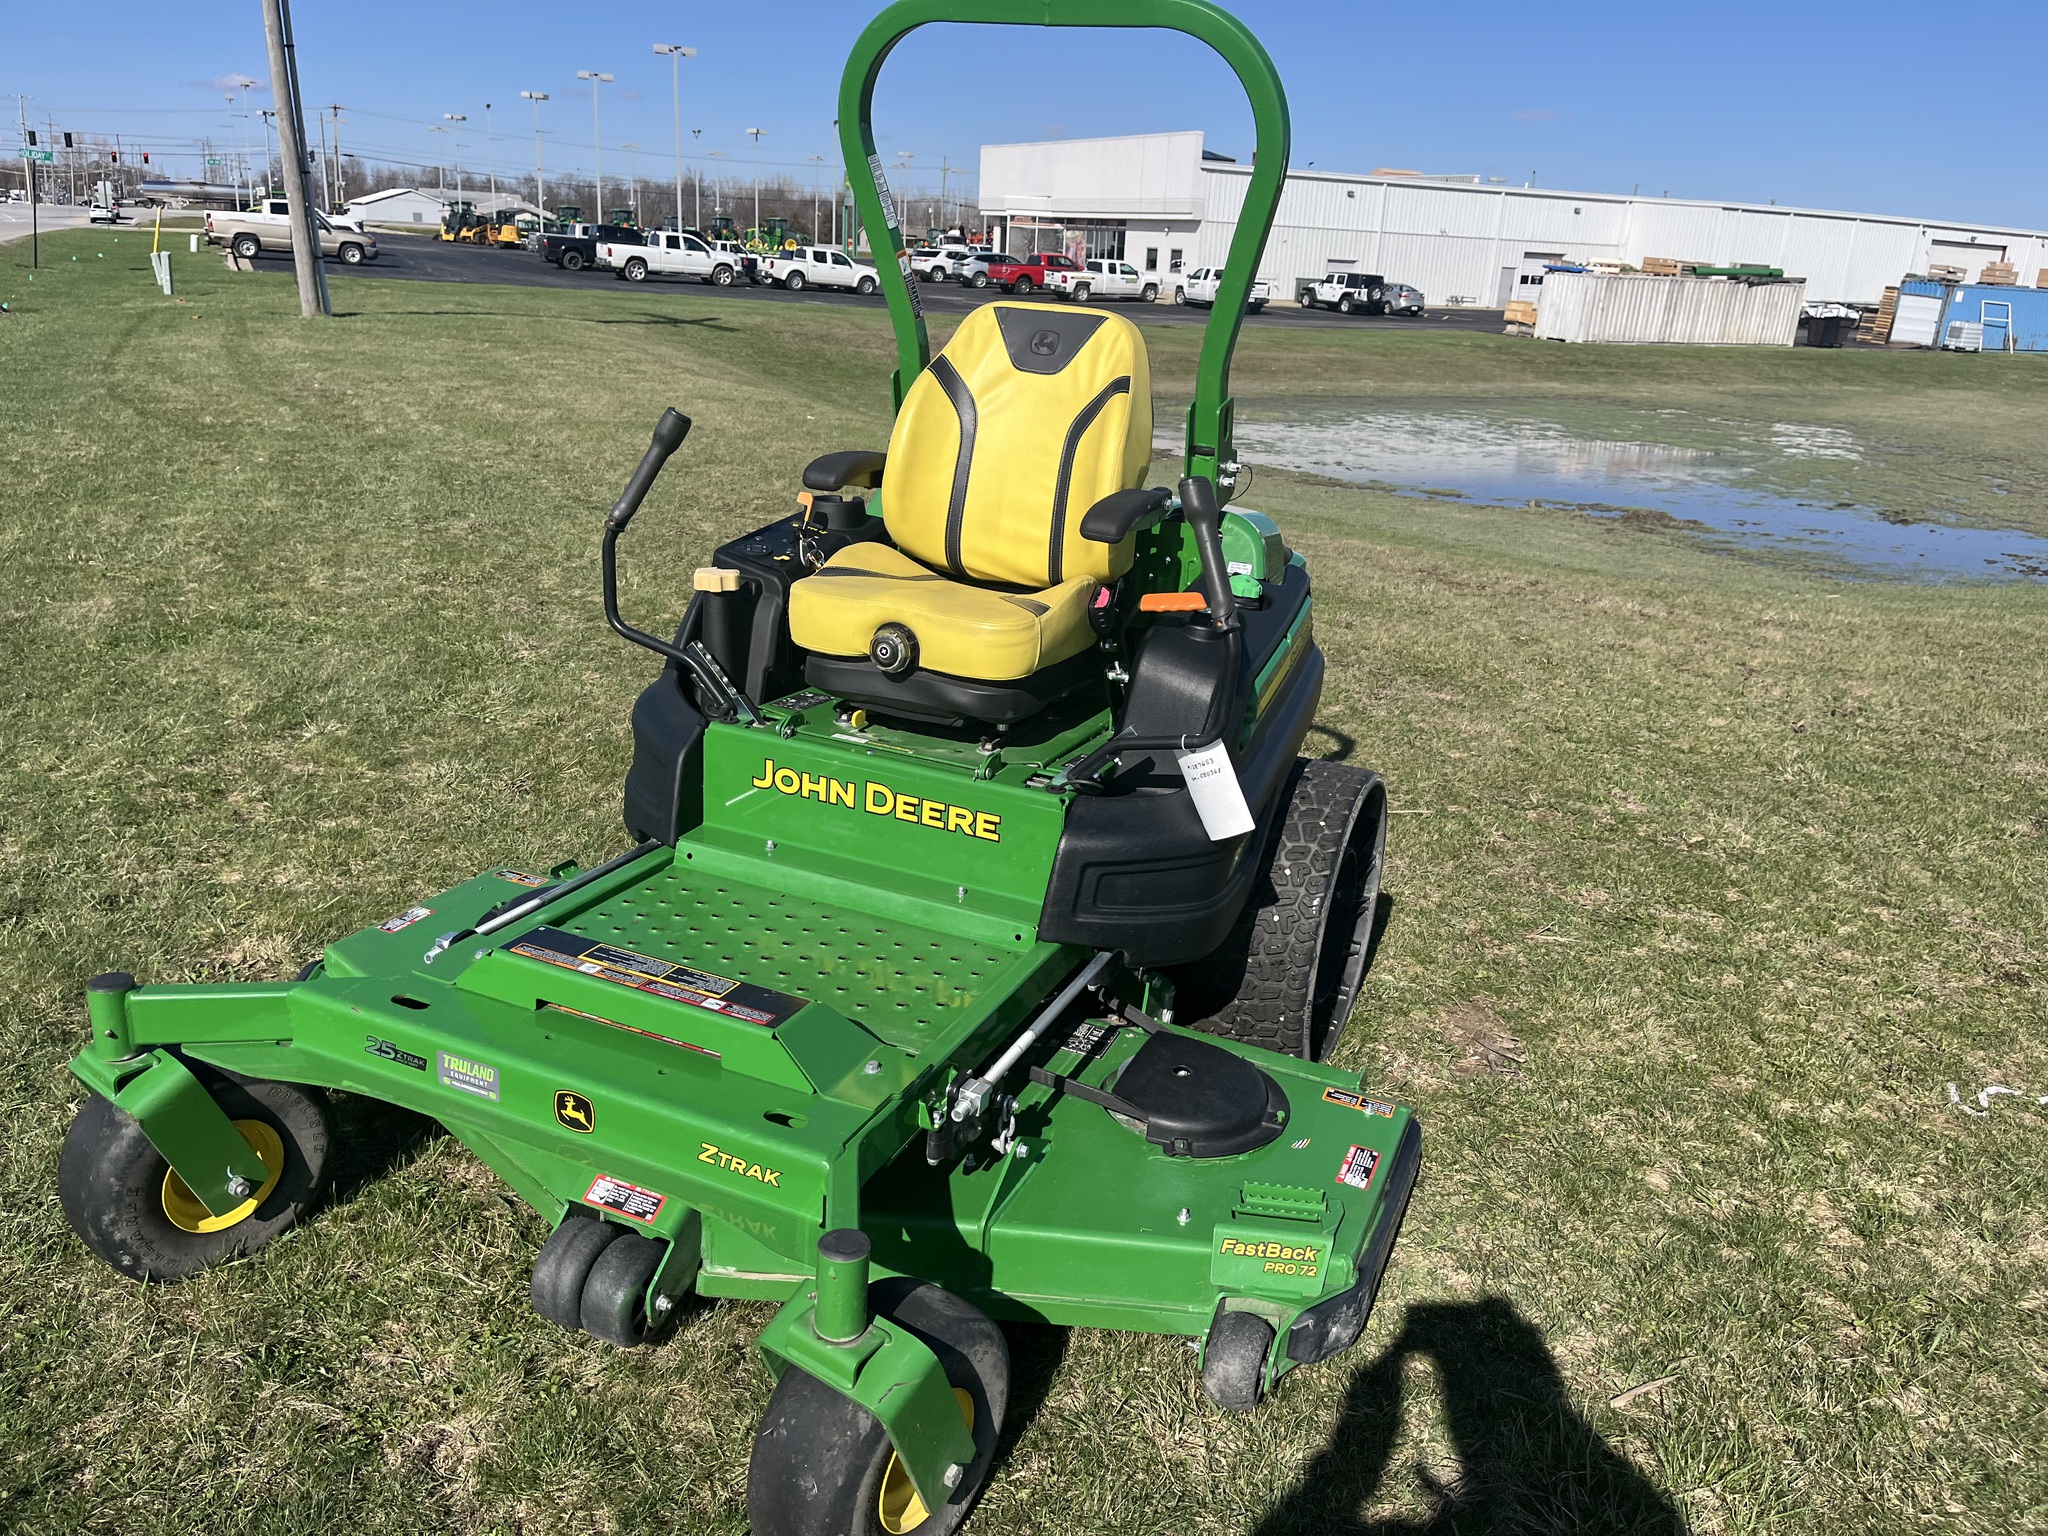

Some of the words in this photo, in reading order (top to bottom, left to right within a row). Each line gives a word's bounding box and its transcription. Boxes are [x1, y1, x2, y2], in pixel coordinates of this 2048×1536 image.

[752, 758, 856, 810] JOHN
[864, 780, 1001, 843] DEERE
[364, 1035, 397, 1060] 25
[396, 1052, 425, 1067] ZTRAK
[442, 1054, 495, 1083] TRULAND
[450, 1070, 489, 1087] EQUIPMENT
[697, 1141, 783, 1188] ZTRAK
[1220, 1238, 1321, 1262] FastBack
[1263, 1261, 1297, 1275] PRO
[1299, 1264, 1318, 1277] 72
